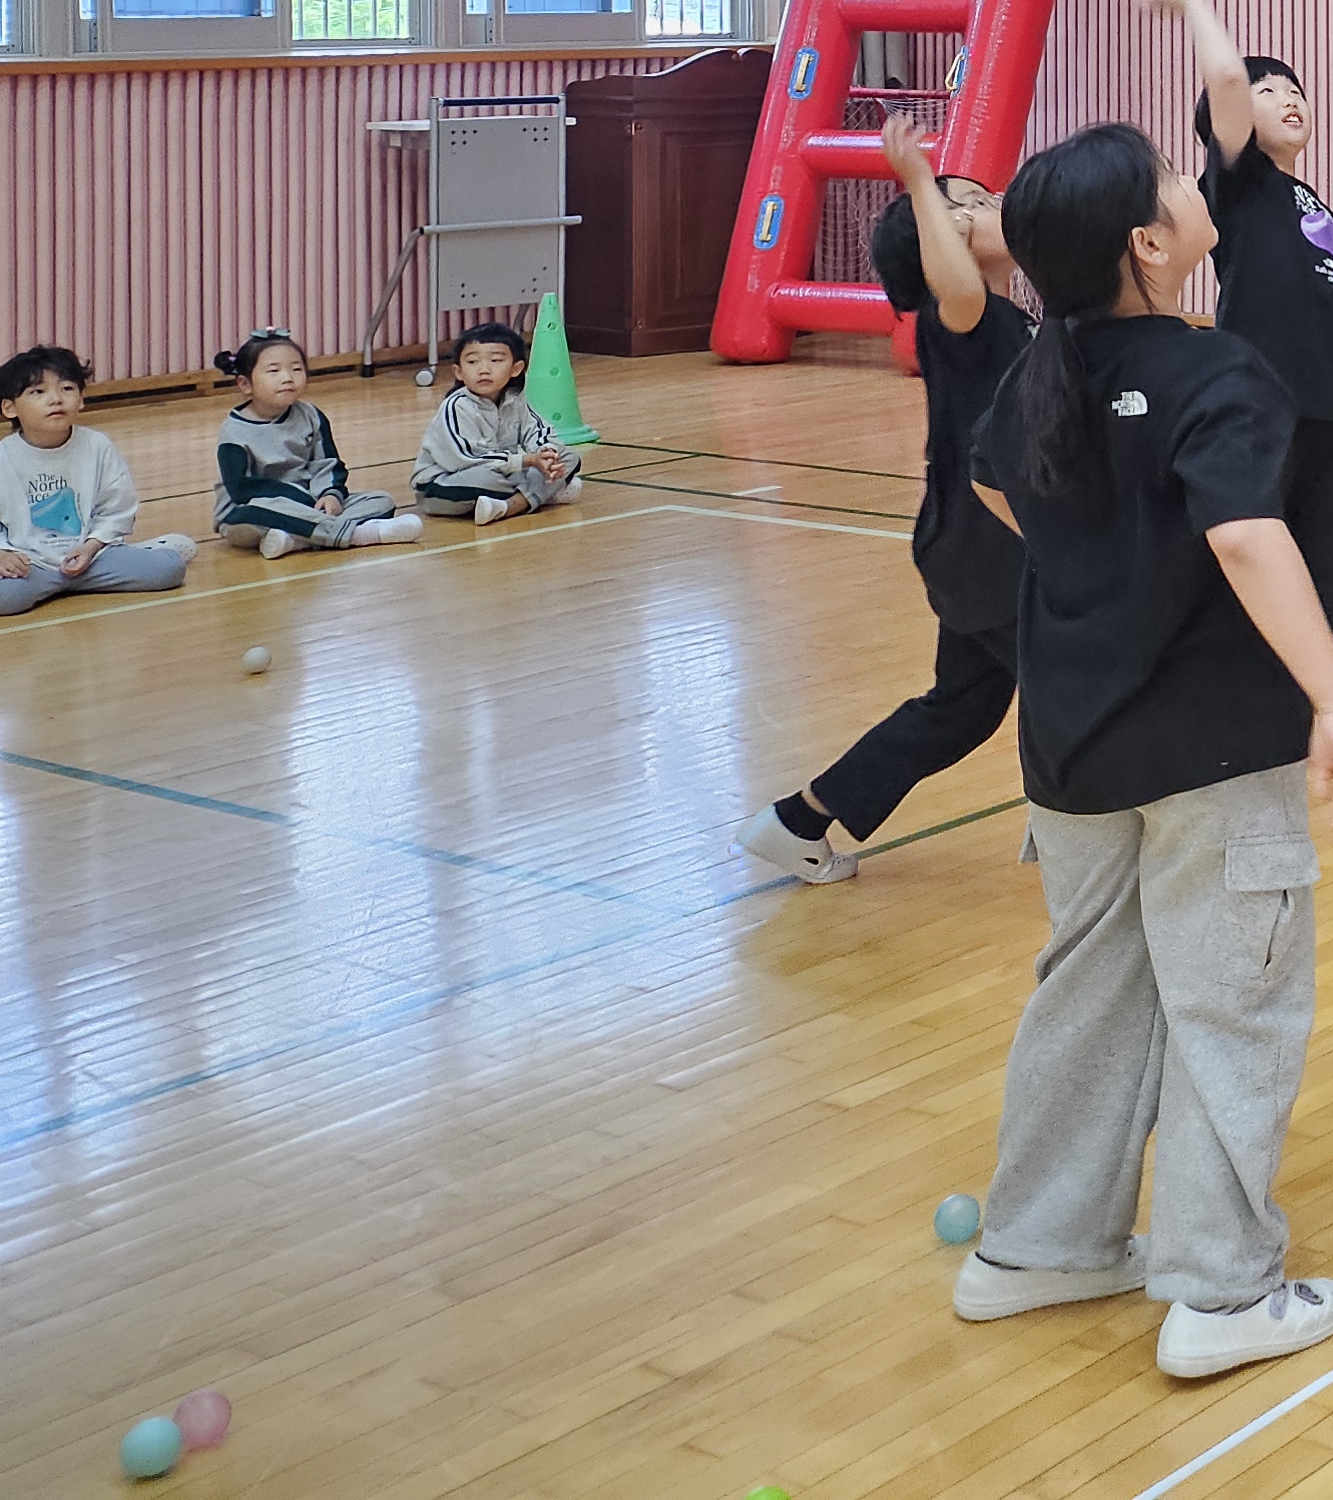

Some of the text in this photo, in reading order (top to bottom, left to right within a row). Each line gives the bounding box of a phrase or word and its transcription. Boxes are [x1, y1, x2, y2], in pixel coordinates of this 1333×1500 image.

[37, 473, 56, 482] The
[28, 475, 68, 494] North
[27, 492, 50, 505] ace
